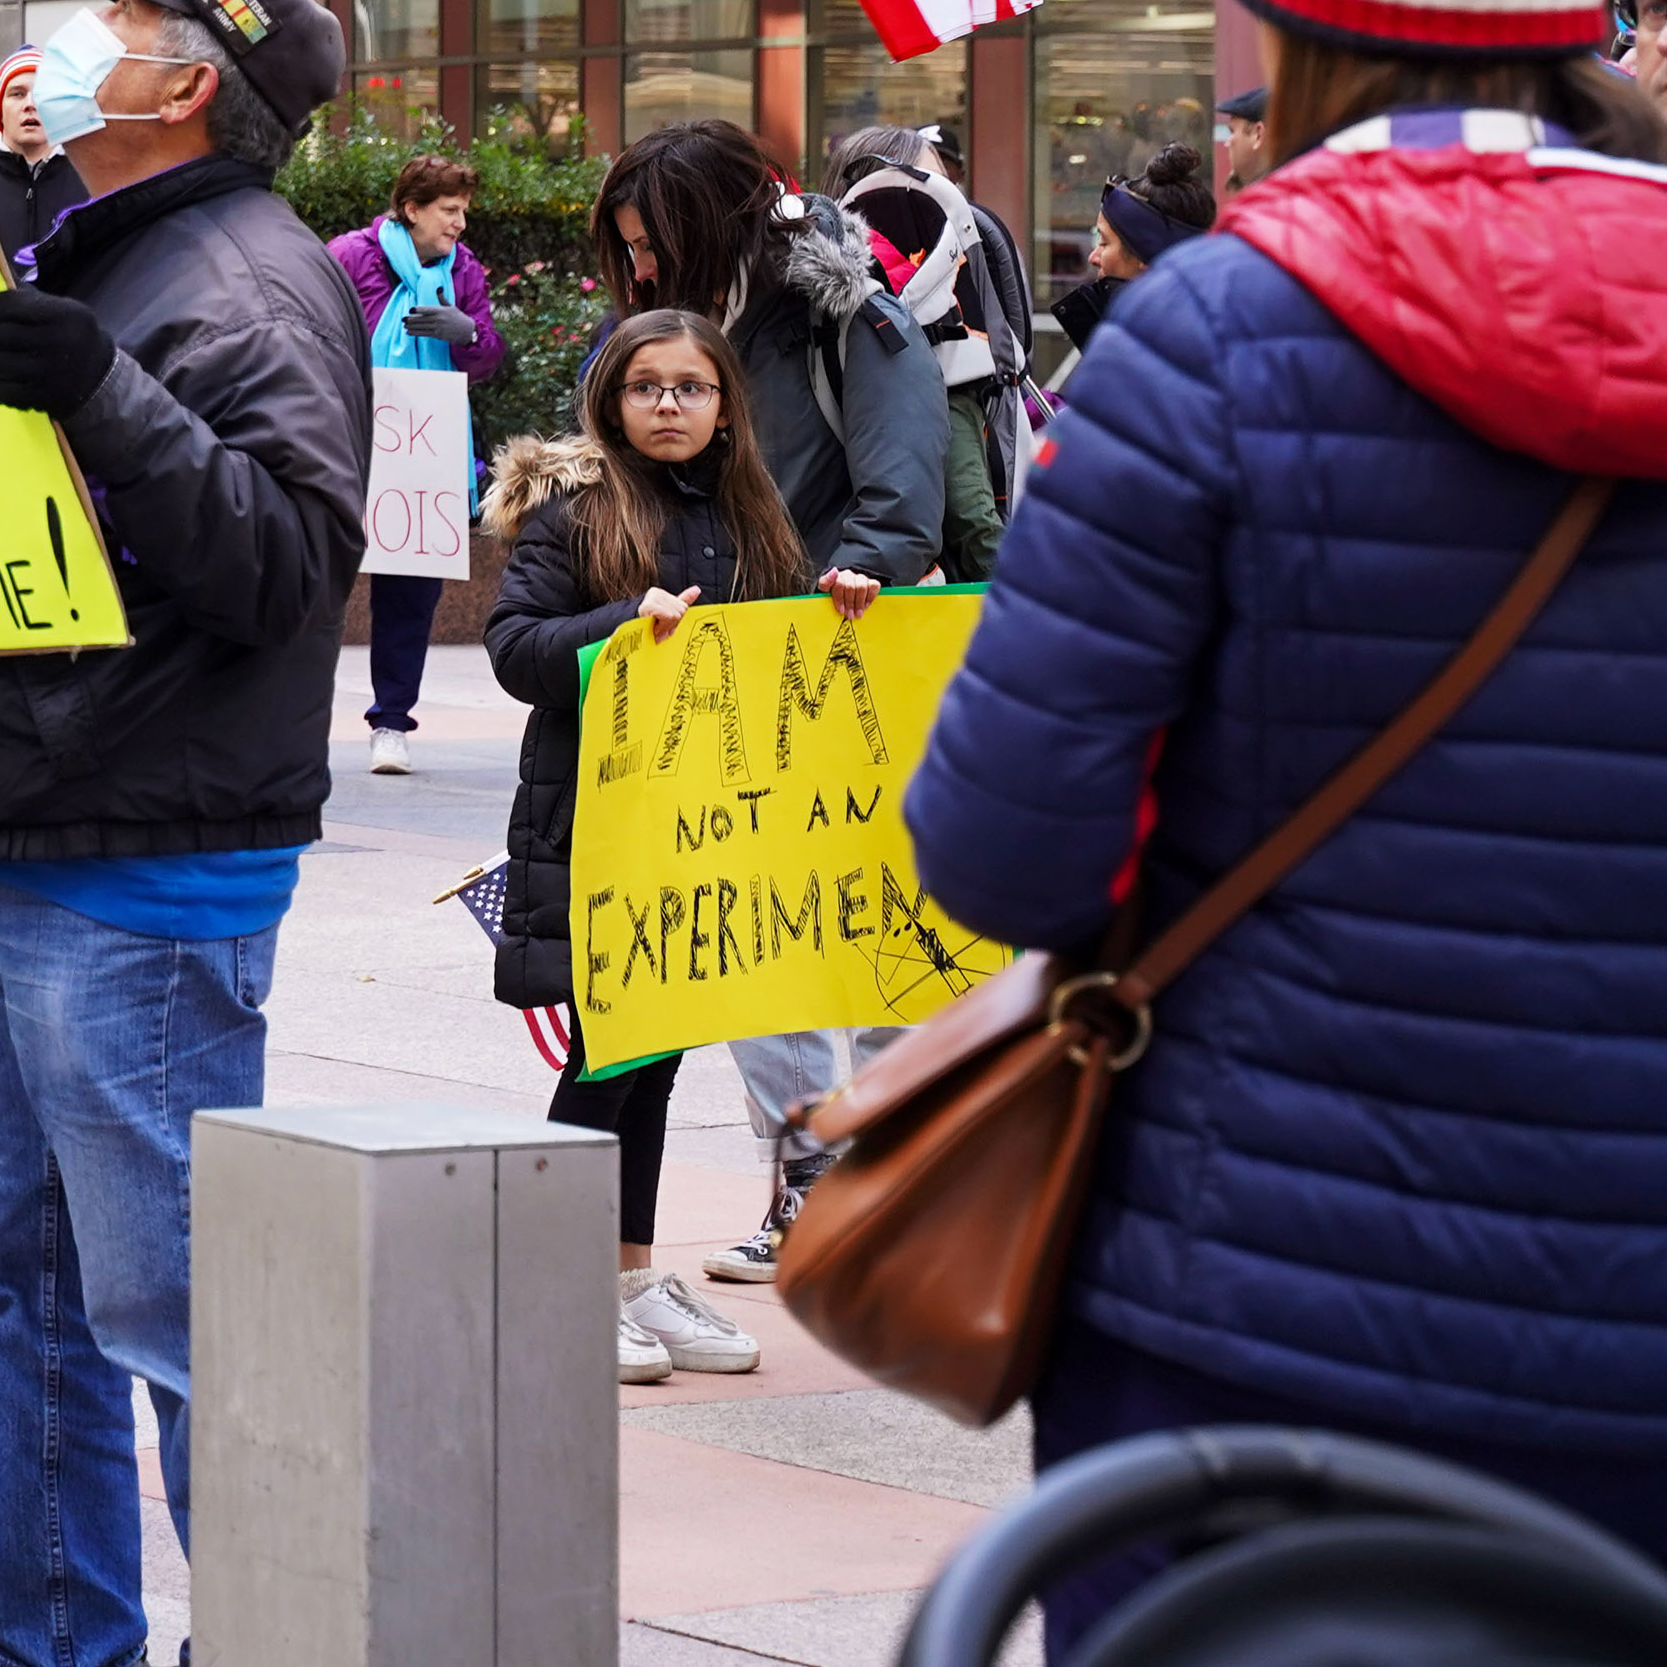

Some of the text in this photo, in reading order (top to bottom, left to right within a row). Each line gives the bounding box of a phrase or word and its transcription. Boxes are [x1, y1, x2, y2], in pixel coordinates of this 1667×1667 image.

[213, 6, 237, 32] ARMY
[597, 610, 890, 793] I AM
[675, 784, 883, 854] NOT AN
[584, 860, 930, 1016] EXPERIMEN
